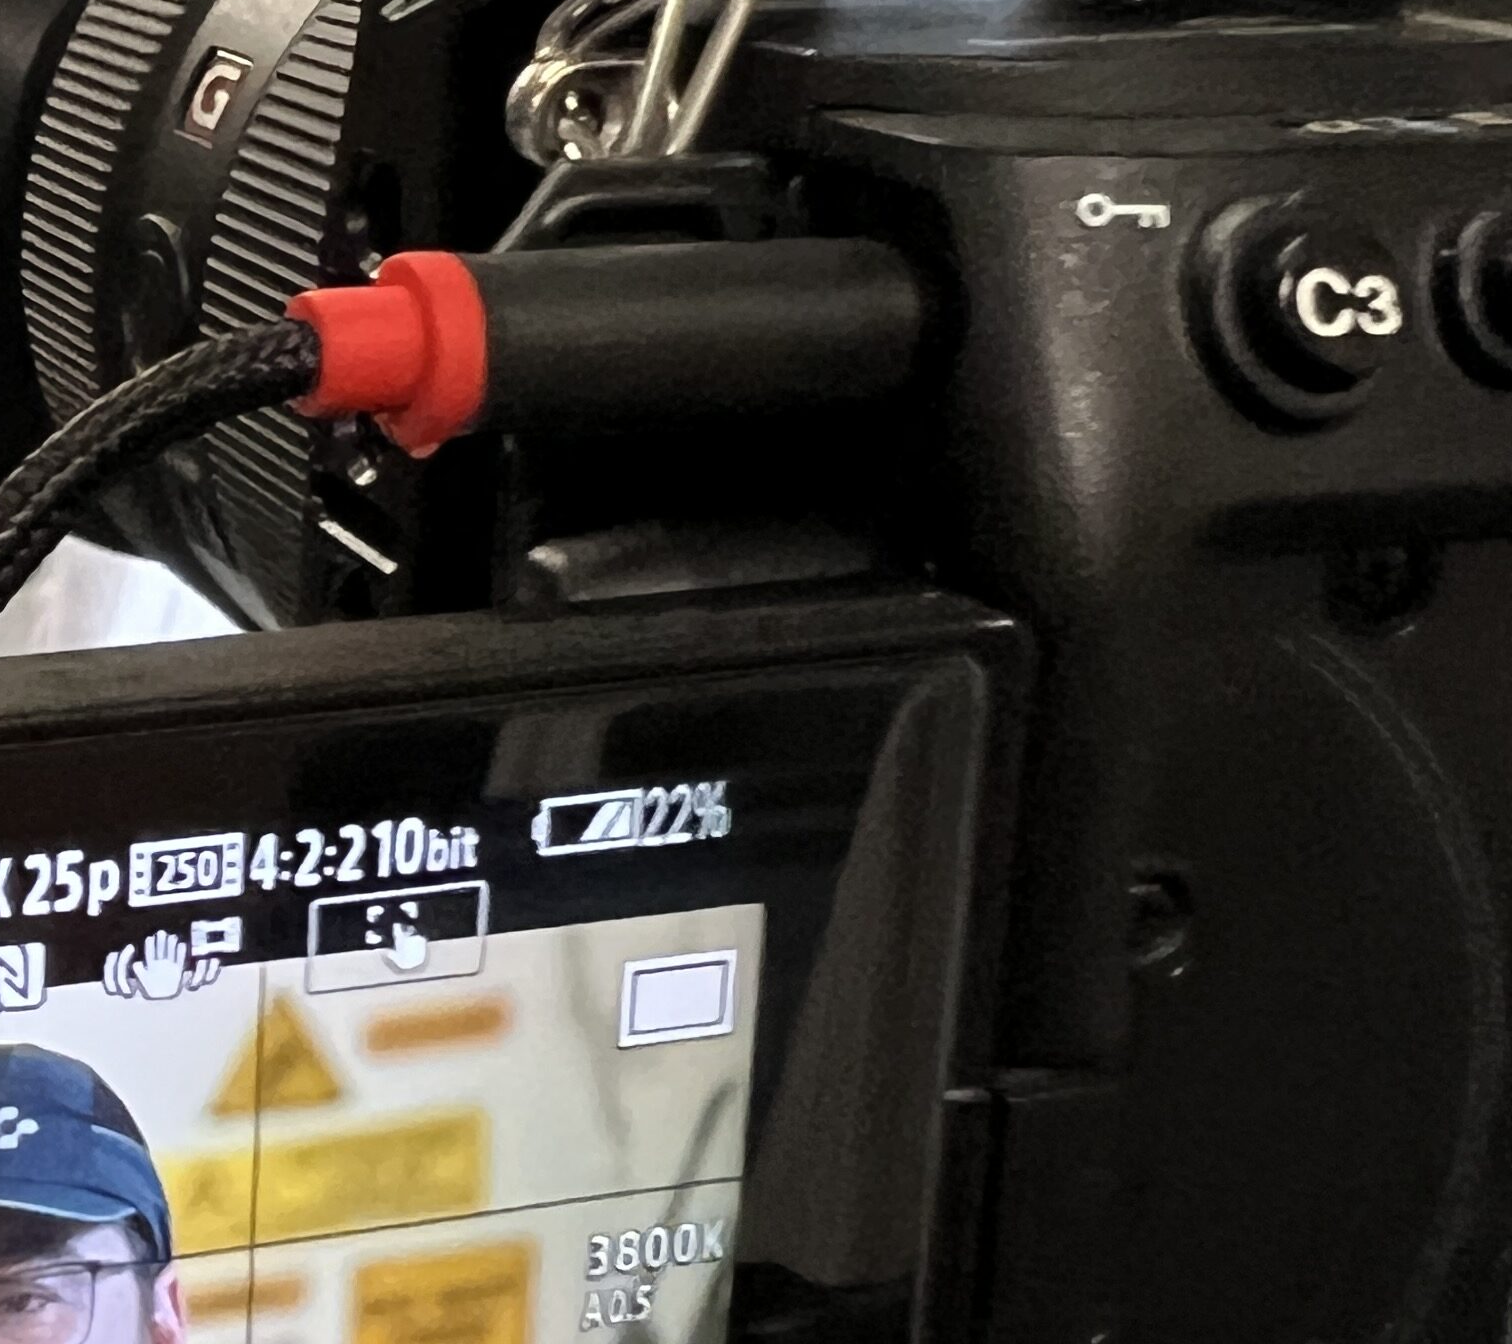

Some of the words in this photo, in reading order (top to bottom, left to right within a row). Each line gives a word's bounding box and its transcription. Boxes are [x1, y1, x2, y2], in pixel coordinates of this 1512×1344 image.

[192, 64, 242, 131] G
[1295, 267, 1402, 337] C3
[644, 780, 733, 843] 22%
[21, 849, 121, 917] 25p
[157, 850, 217, 893] 250
[588, 1219, 725, 1278] 3800K
